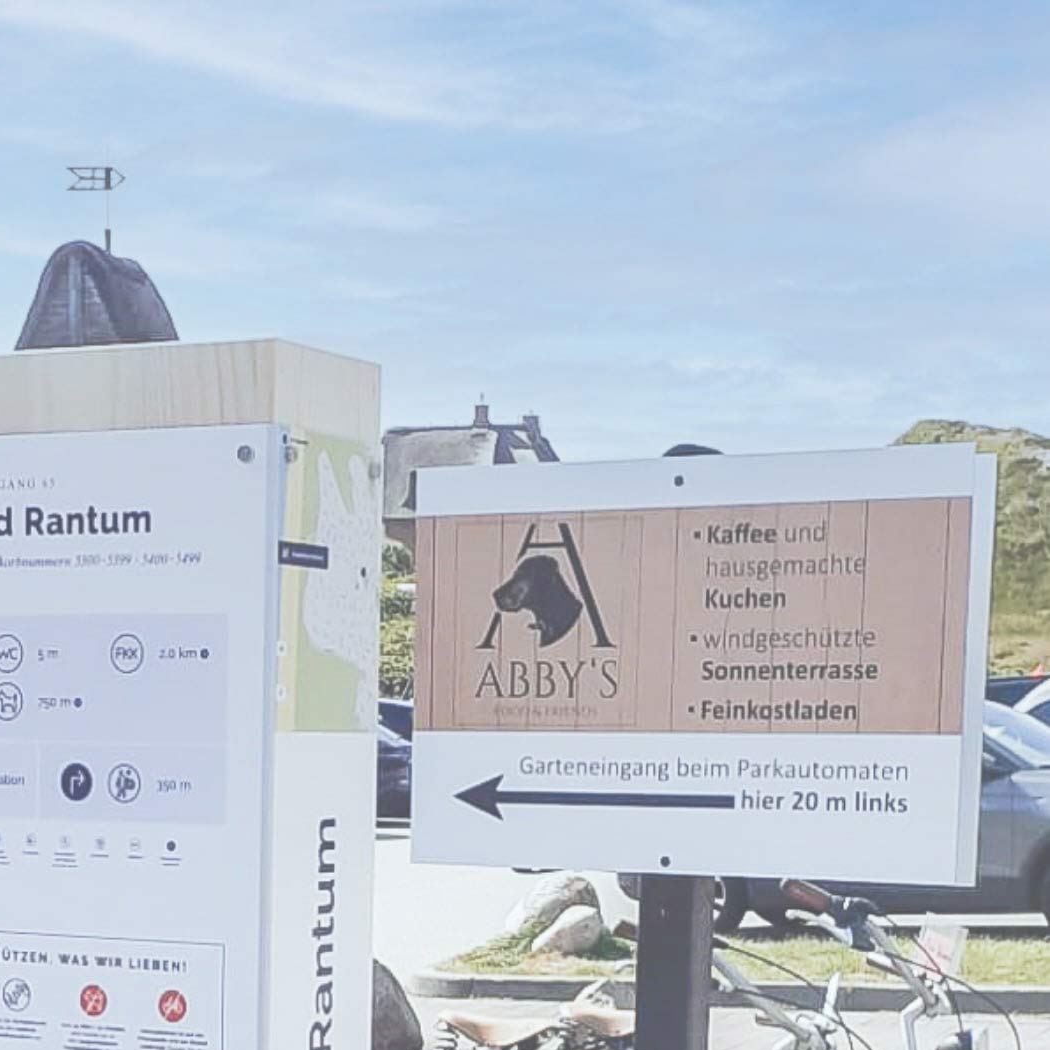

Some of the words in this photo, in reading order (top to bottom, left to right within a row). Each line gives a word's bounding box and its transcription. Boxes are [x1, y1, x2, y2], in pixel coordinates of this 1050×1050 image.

[25, 505, 151, 536] Rantum
[707, 522, 777, 544] Kaffee
[784, 518, 826, 543] und
[705, 554, 866, 581] hausgemachte
[705, 587, 786, 609] Kuchen
[178, 646, 198, 659] km
[703, 627, 876, 653] windgeschützte
[474, 657, 618, 699] ABBY'S
[701, 660, 879, 681] Sonnenterrasse
[700, 699, 858, 721] Feinkostladen
[519, 755, 670, 782] Garteneingang
[677, 756, 730, 778] beim
[737, 758, 909, 782] Parkautomaten
[741, 789, 785, 811] hier
[791, 791, 819, 811] 20
[825, 796, 847, 812] m
[855, 791, 908, 814] links
[58, 953, 89, 967] WAS
[94, 956, 123, 968] WIR
[128, 957, 187, 973] LIEBEN!
